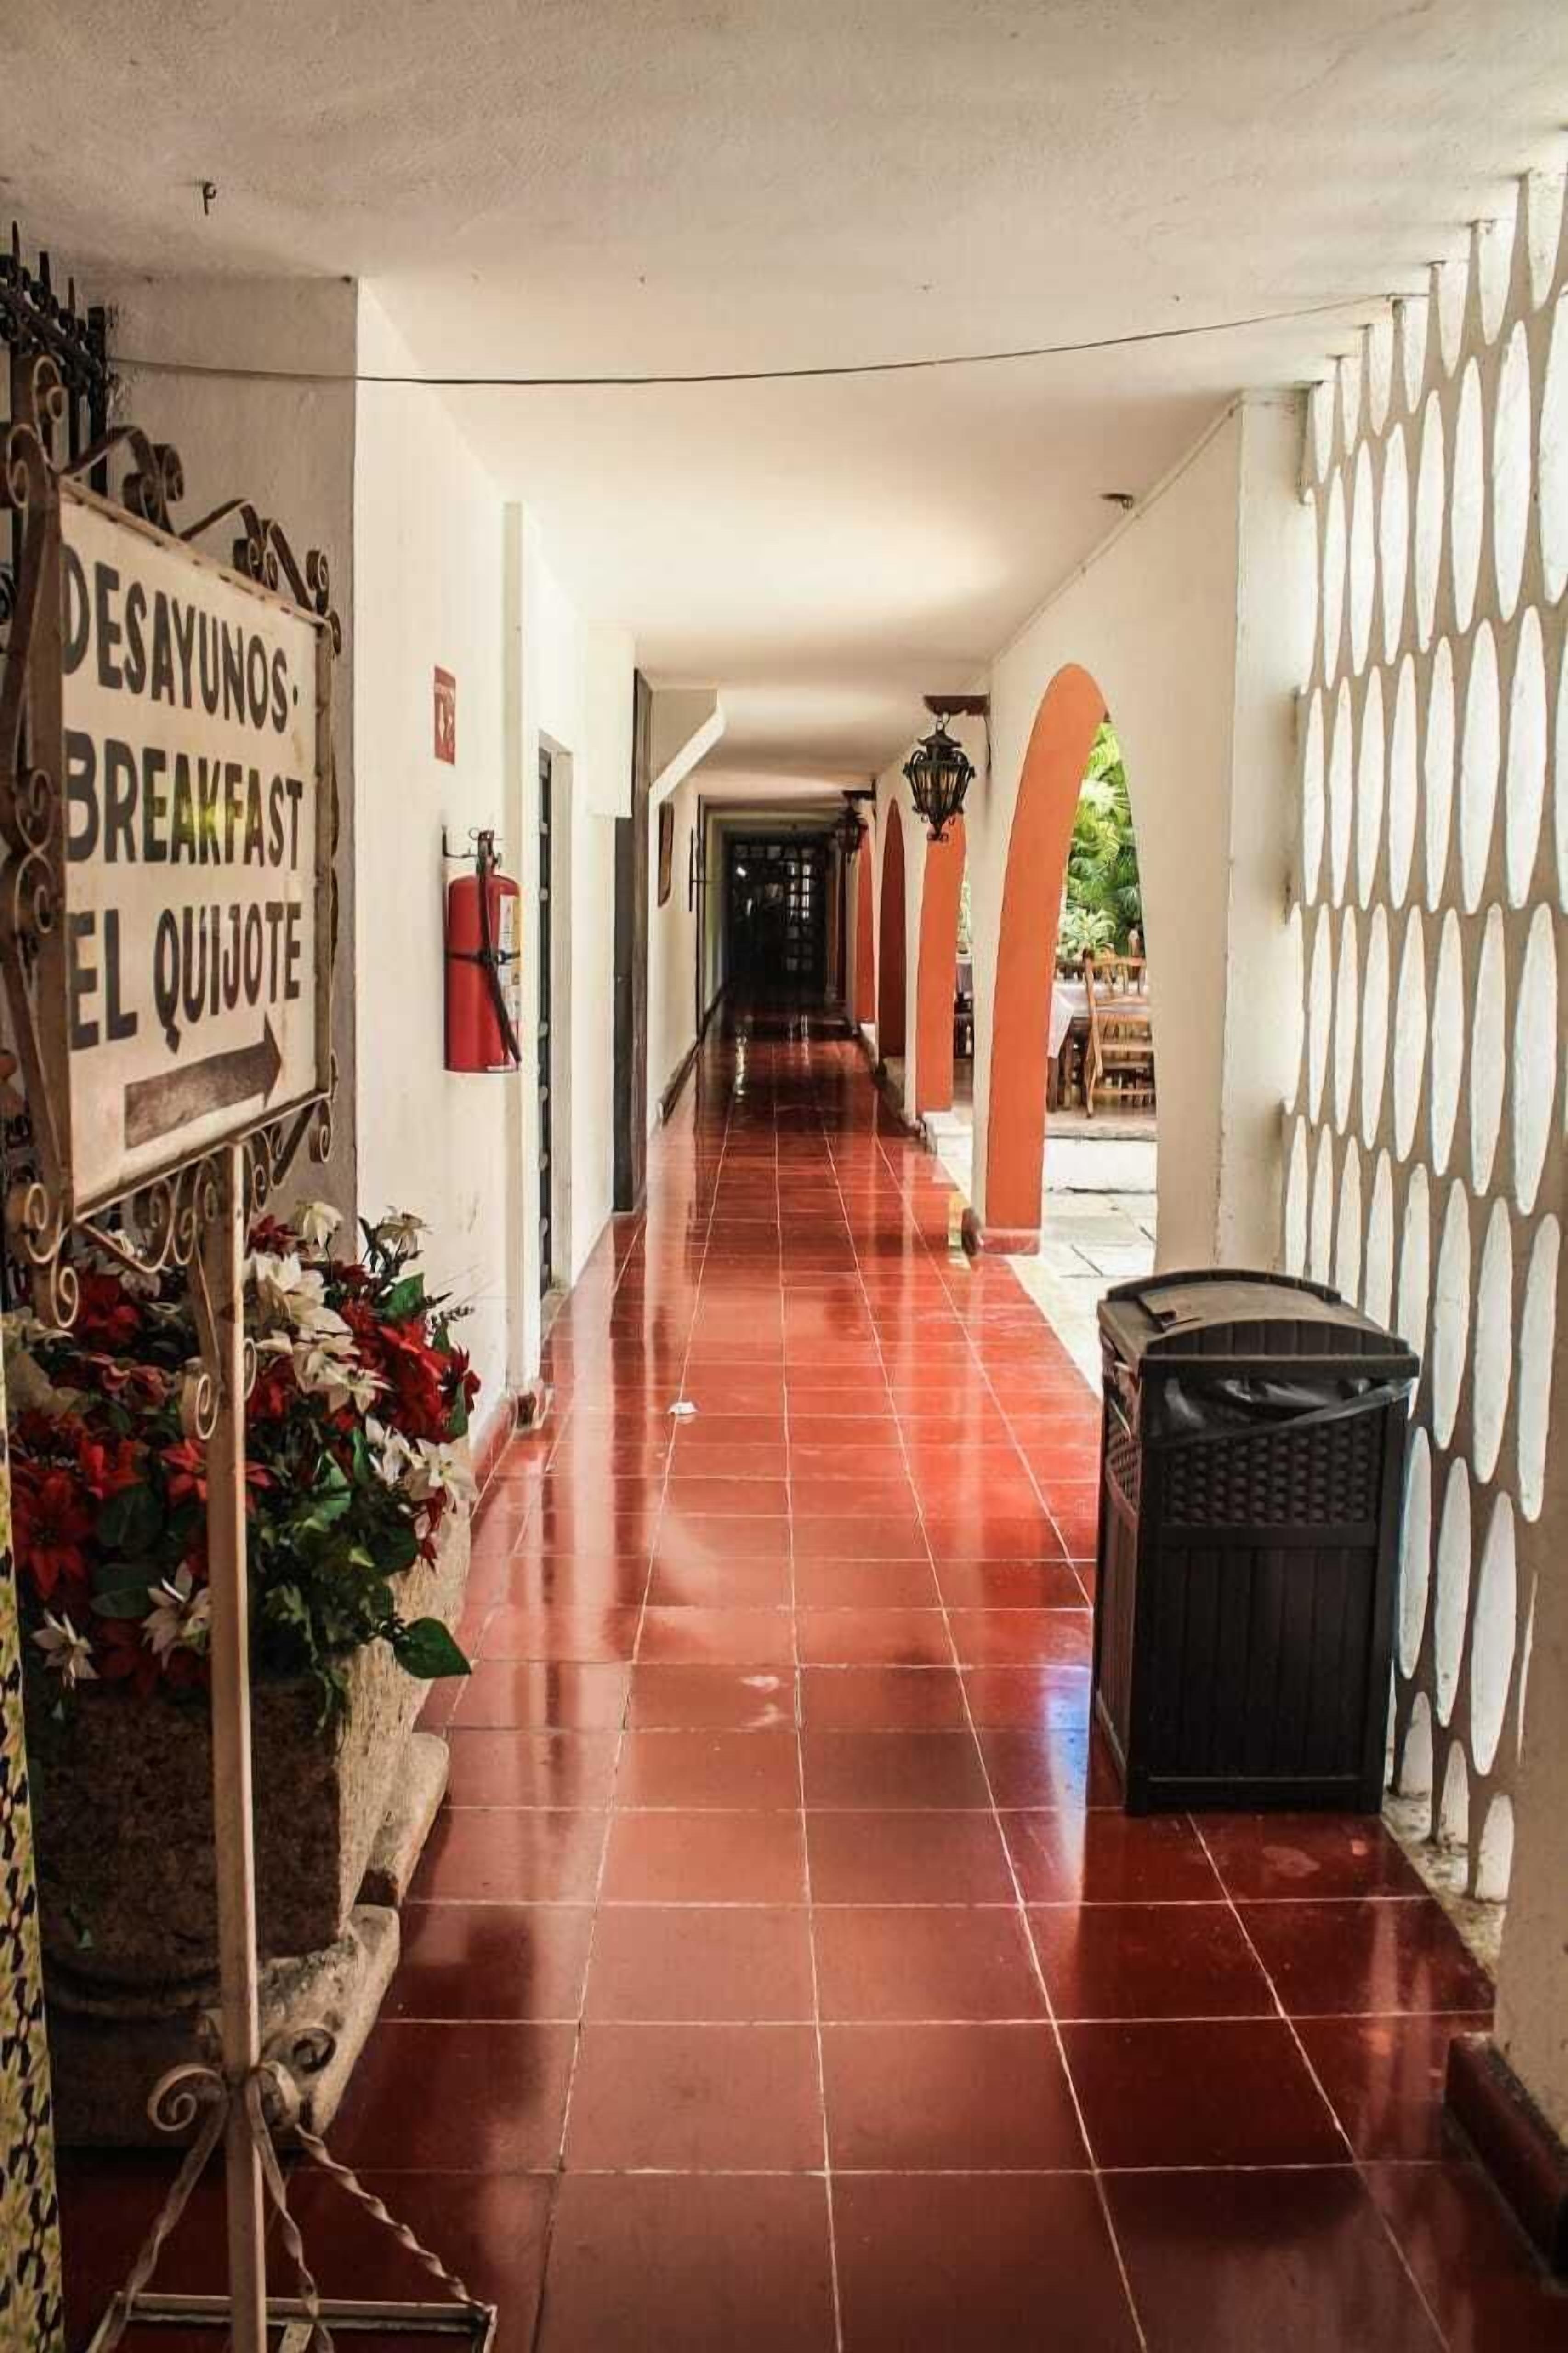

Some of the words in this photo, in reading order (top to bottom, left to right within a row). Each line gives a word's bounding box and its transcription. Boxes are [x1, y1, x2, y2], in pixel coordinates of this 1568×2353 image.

[64, 729, 303, 870] BREAKFAST
[68, 908, 138, 1051] EL
[153, 901, 301, 1054] QUIJOTE
